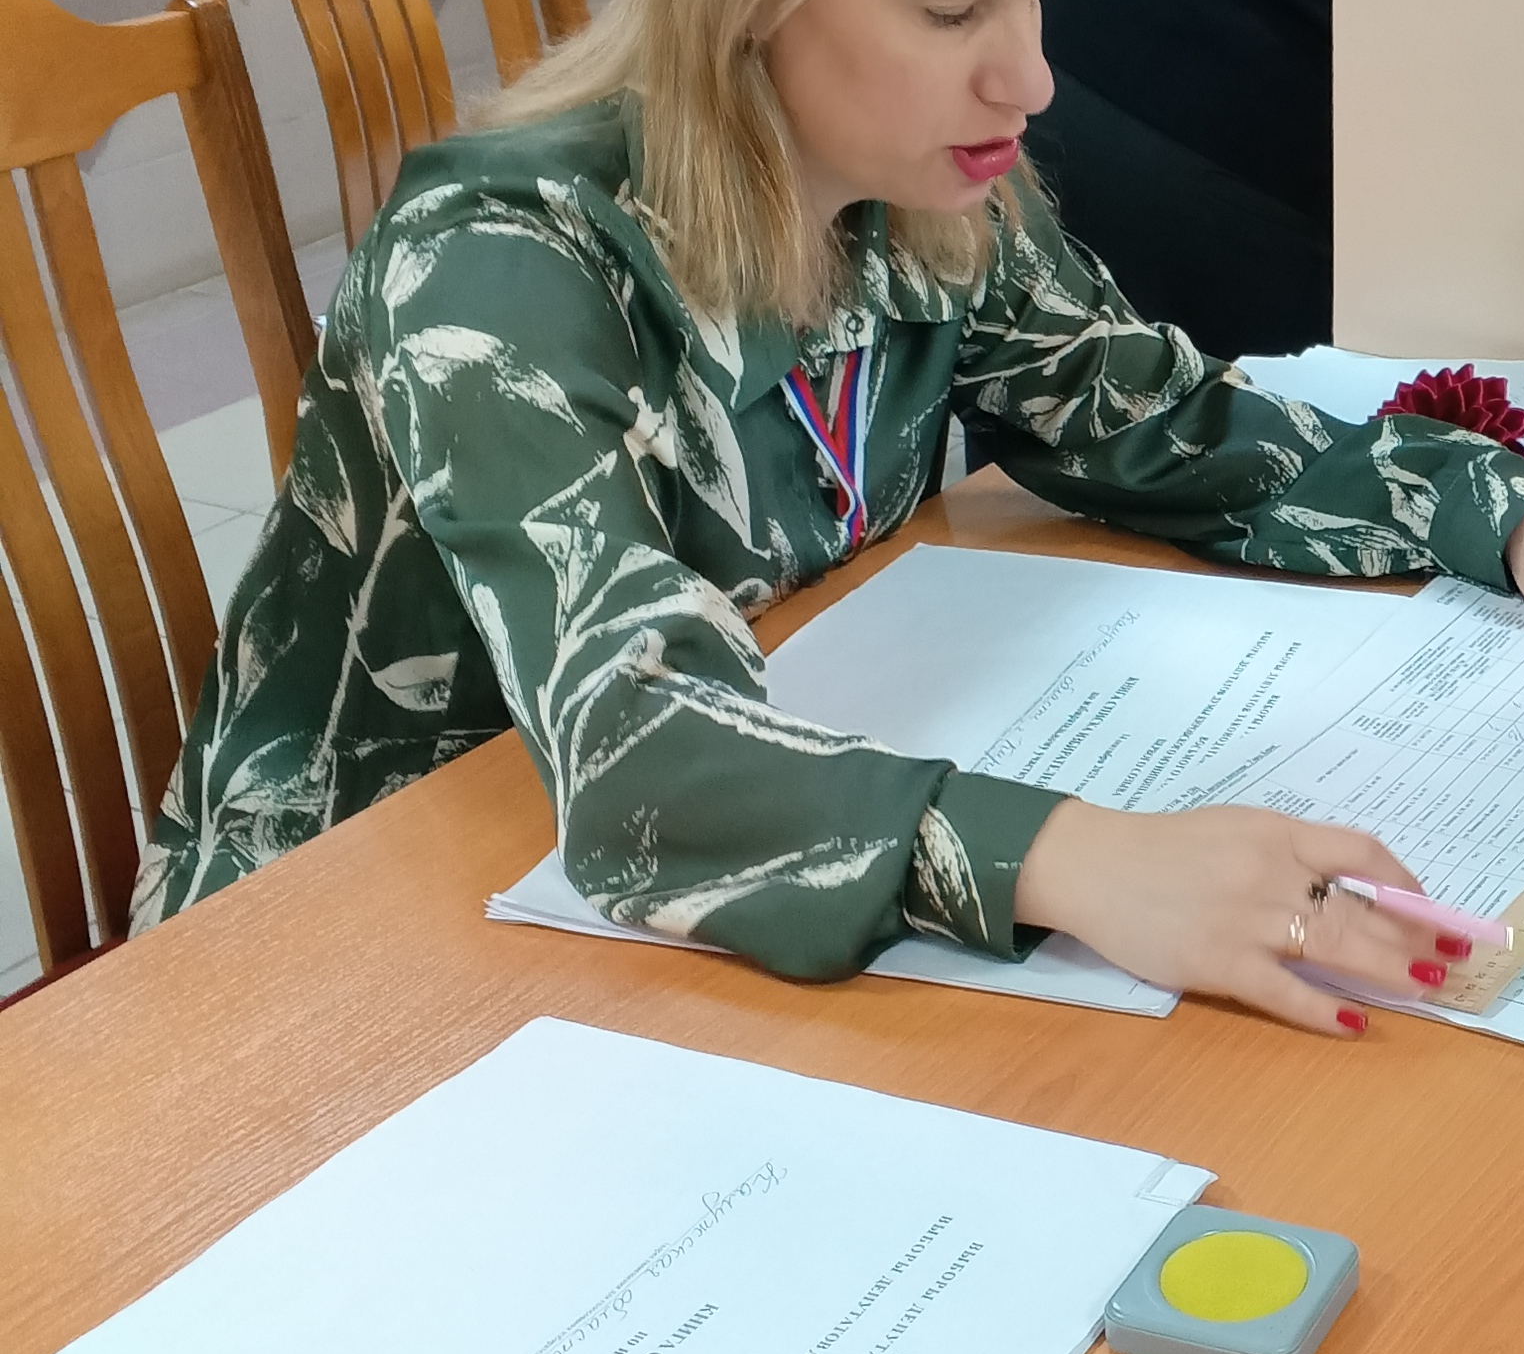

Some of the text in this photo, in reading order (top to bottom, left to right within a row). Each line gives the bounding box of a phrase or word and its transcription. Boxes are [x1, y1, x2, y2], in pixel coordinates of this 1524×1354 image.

[889, 1214, 954, 1274] ВЫБОРЫ
[919, 1241, 984, 1301] ВЫБОРЫ
[625, 1330, 648, 1346] по
[657, 1302, 719, 1349] КНИГА
[815, 1274, 893, 1350] ДЕПУТАТОВ
